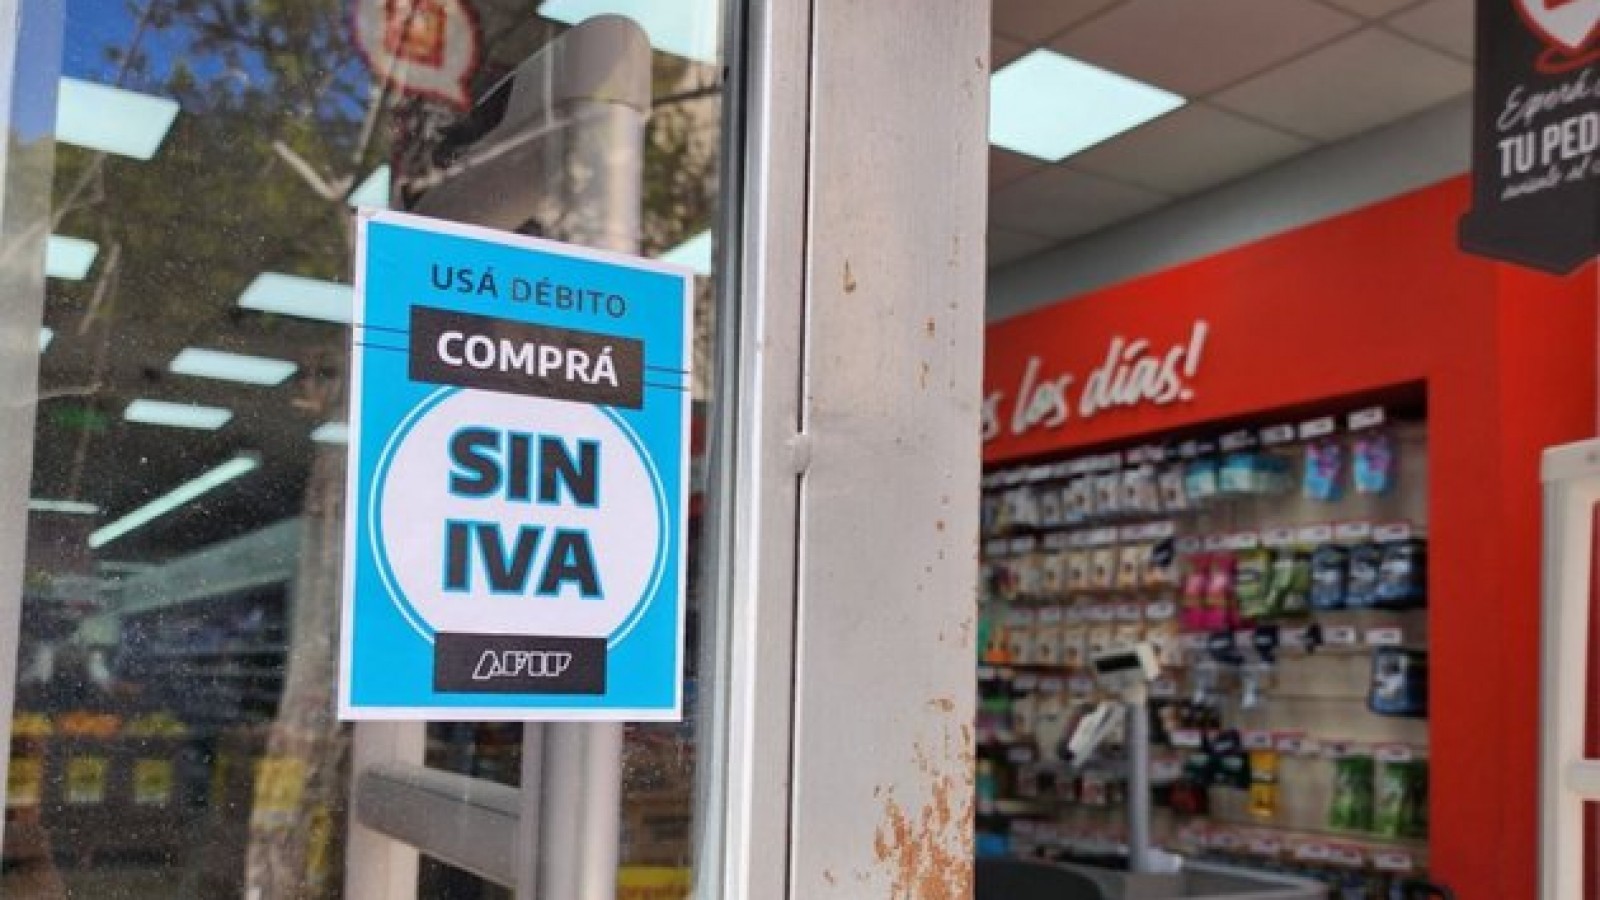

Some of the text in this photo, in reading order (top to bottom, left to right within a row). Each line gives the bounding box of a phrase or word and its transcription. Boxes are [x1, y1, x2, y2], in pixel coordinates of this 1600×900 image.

[1498, 131, 1534, 177] TU
[431, 263, 627, 319] USÁ DÉBITO
[436, 331, 619, 387] COMPRÁ
[1012, 355, 1075, 436] los
[1078, 318, 1209, 419] días!
[448, 425, 603, 508] SIN
[442, 517, 605, 600] IVA
[472, 650, 573, 680] AFIP
